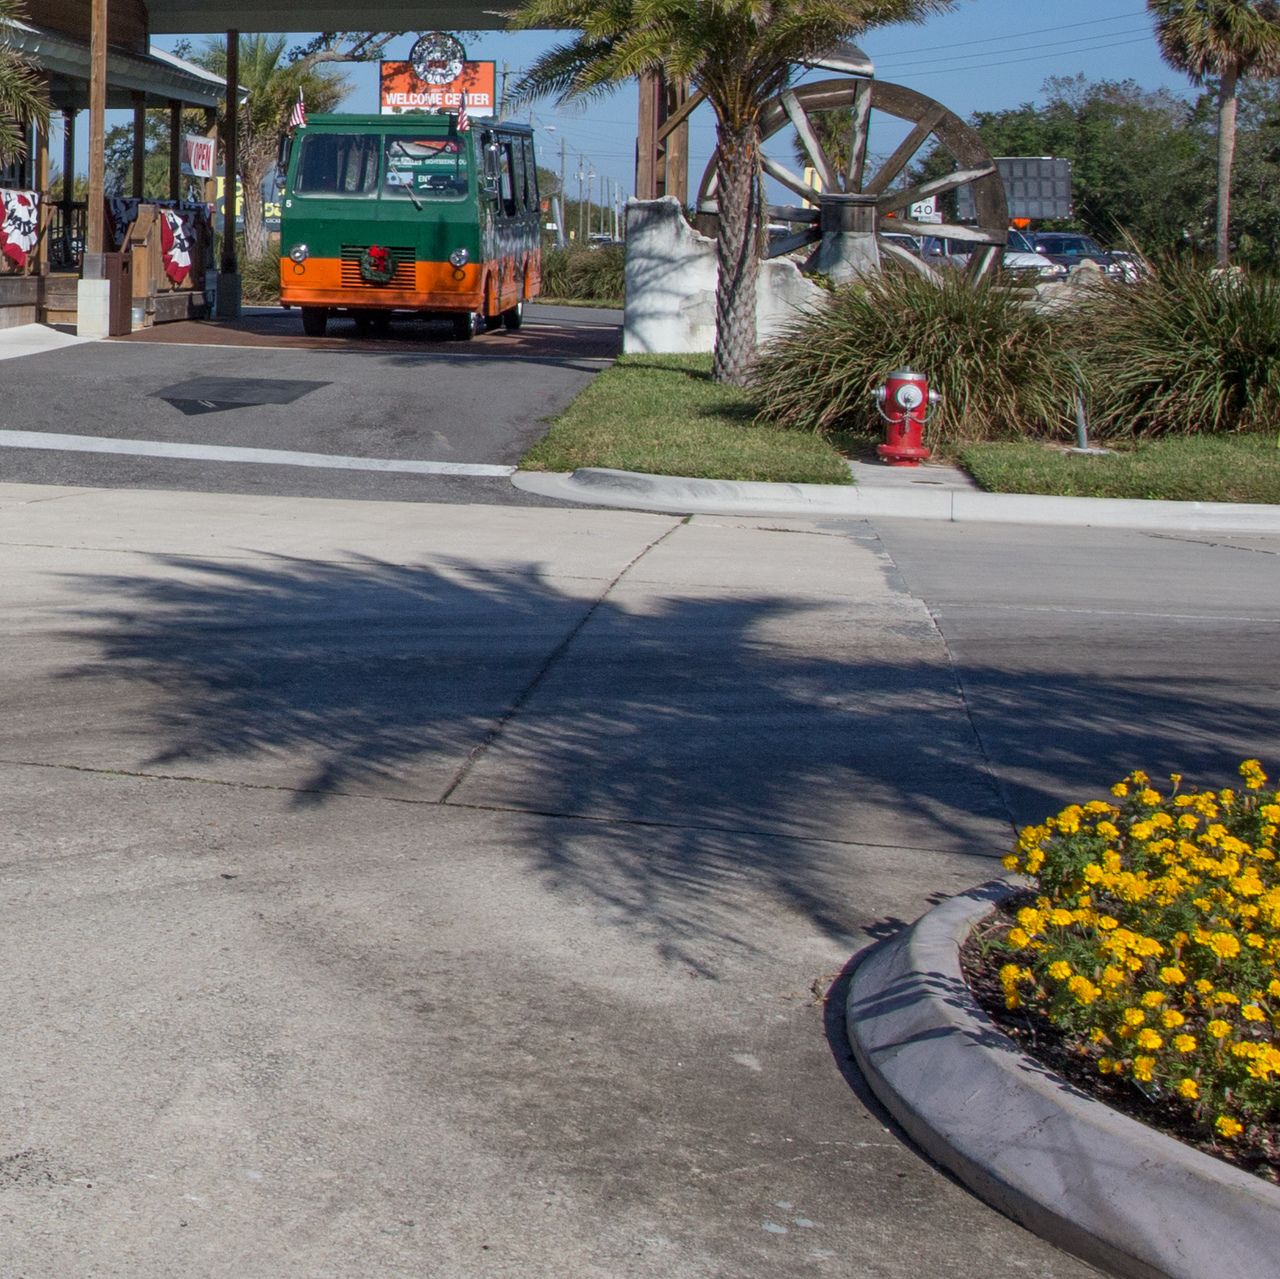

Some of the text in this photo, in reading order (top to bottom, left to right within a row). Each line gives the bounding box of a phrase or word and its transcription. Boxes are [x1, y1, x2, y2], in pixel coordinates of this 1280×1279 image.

[385, 92, 443, 106] WELCOME
[193, 142, 211, 171] OPEN
[913, 205, 933, 215] 40
